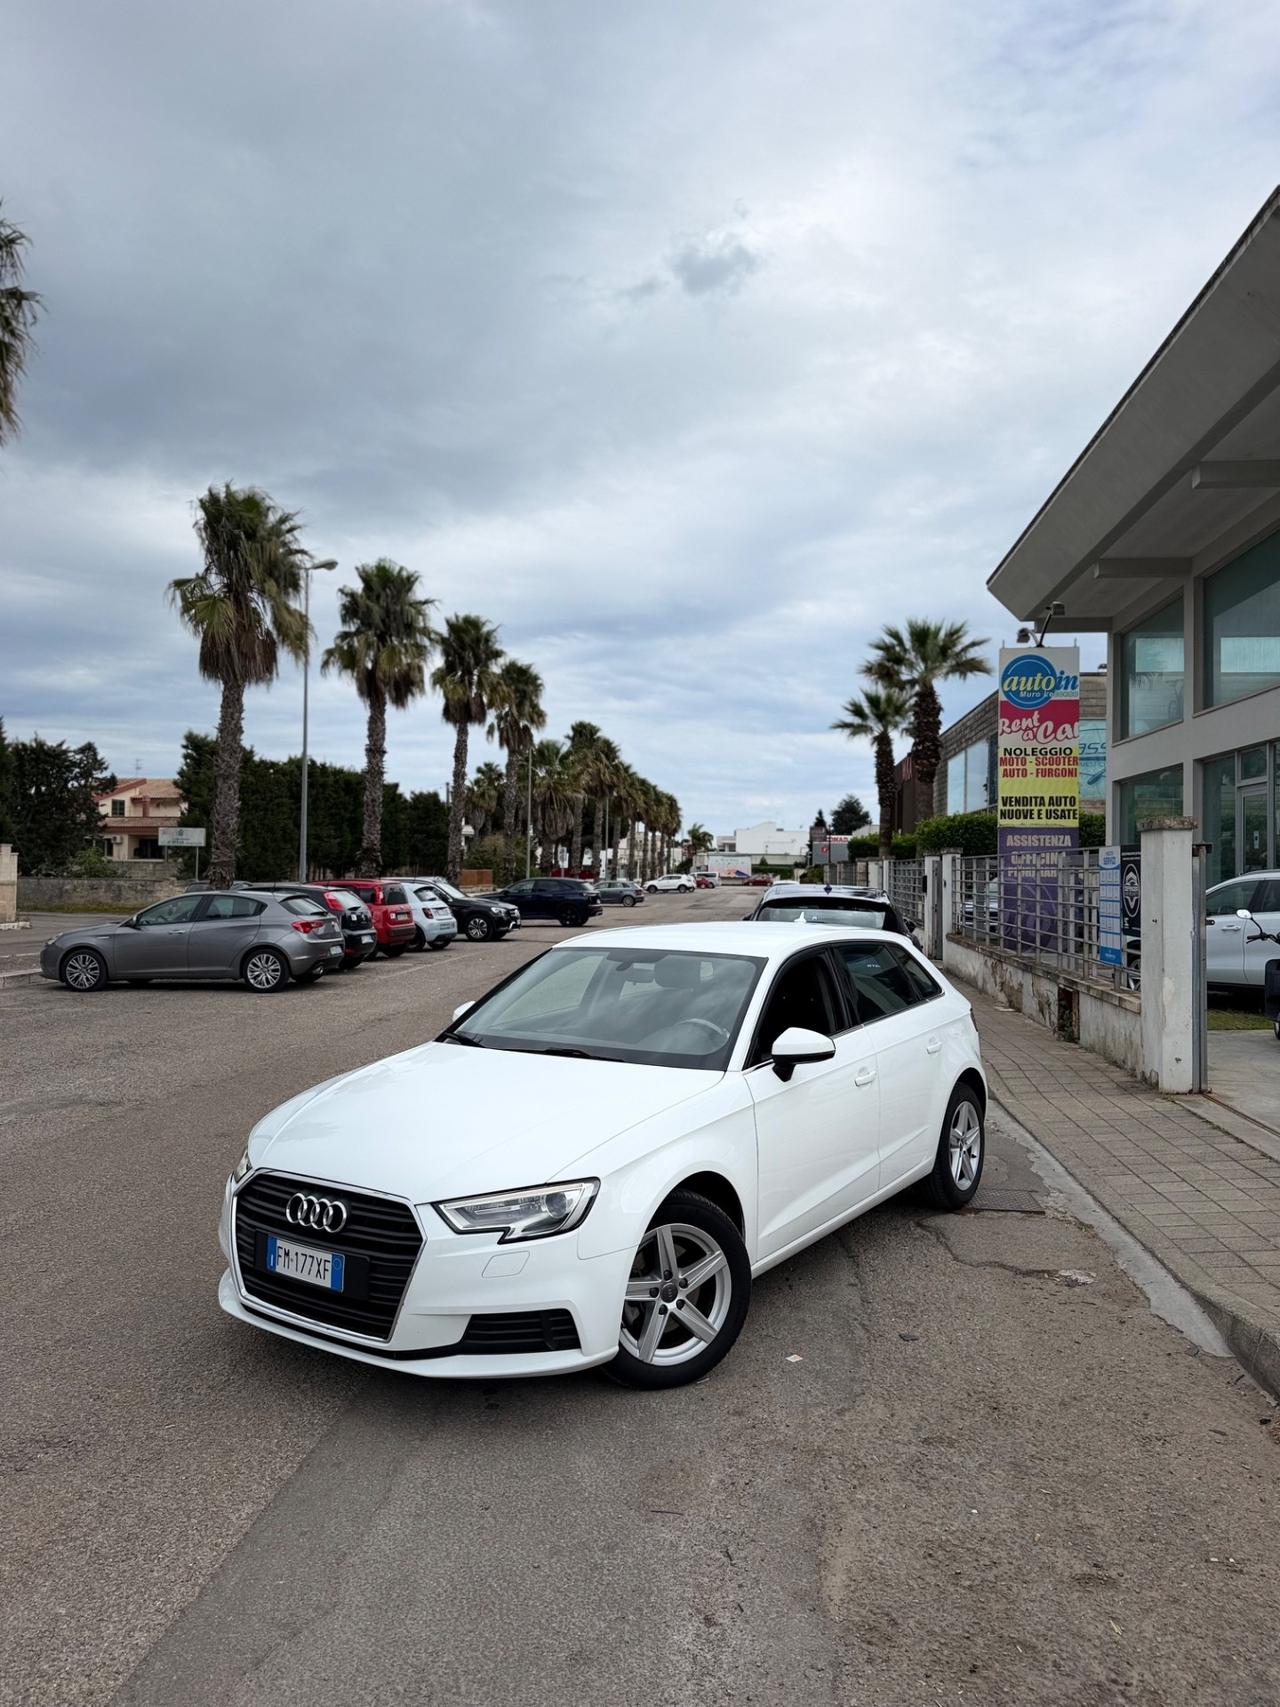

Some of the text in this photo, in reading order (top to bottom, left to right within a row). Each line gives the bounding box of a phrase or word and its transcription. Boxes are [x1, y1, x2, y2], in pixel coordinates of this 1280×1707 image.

[998, 710, 1040, 736] Rent
[1003, 747, 1073, 756] NOLEGGIO
[999, 757, 1027, 766] MOTO
[1035, 756, 1079, 766] SCOOTER
[1002, 768, 1028, 778] AUTO
[1035, 768, 1078, 778] FURGONI
[1001, 796, 1076, 807] VENDITA AUTO
[1000, 809, 1078, 820] NUOVE E USATE
[1006, 835, 1072, 846] ASSISTENZA
[1011, 851, 1066, 864] OFFICIN
